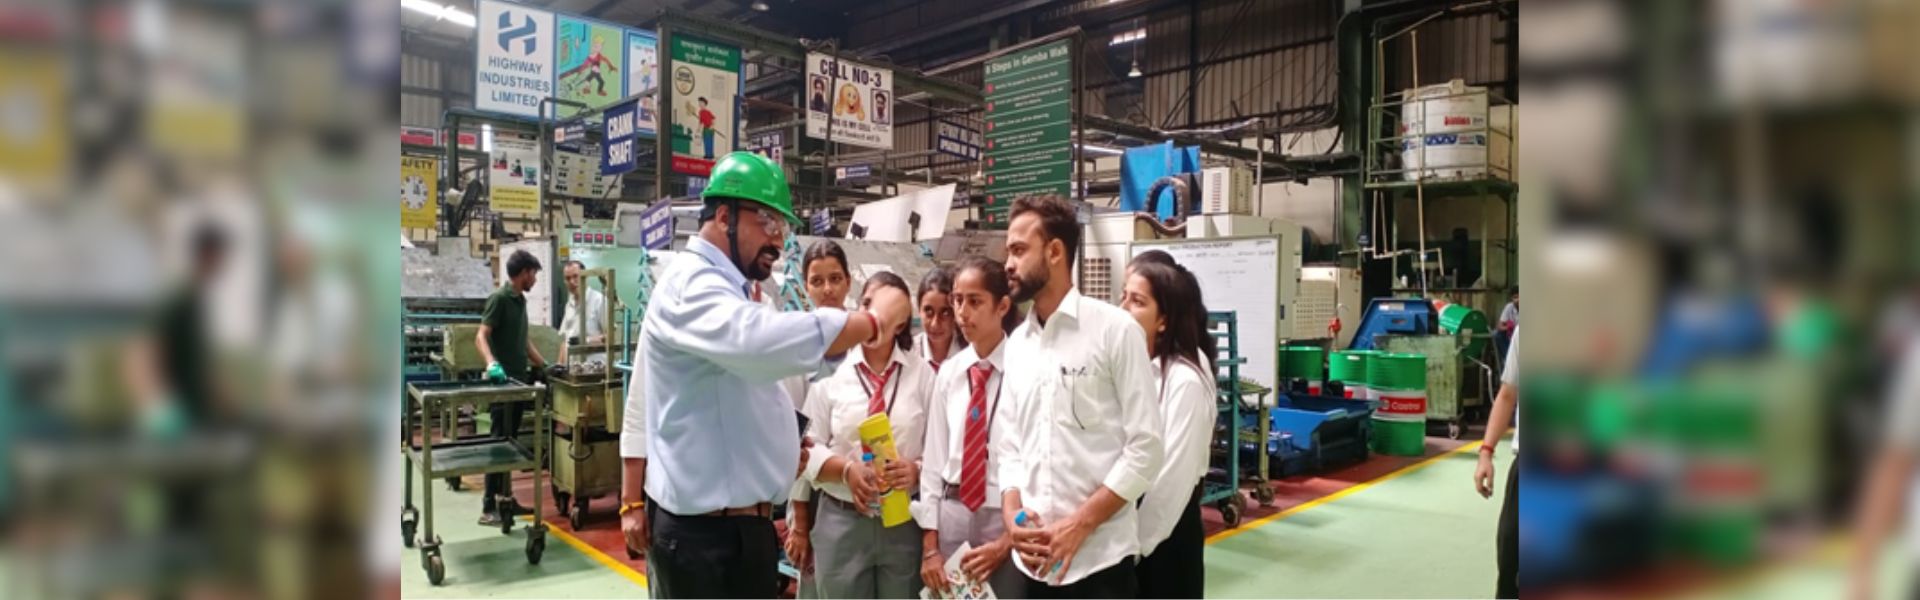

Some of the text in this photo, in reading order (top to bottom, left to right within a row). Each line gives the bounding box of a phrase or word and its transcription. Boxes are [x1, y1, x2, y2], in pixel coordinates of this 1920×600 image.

[488, 55, 543, 75] HIGHWAY
[992, 61, 1012, 73] Steps
[1022, 51, 1048, 66] Gemba
[479, 71, 551, 93] INDUSTRIES
[852, 67, 882, 87] NO-3
[491, 89, 538, 107] LIMITED
[608, 111, 634, 140] CRANK
[608, 139, 632, 167] SHAFT
[401, 158, 434, 170] AFETY
